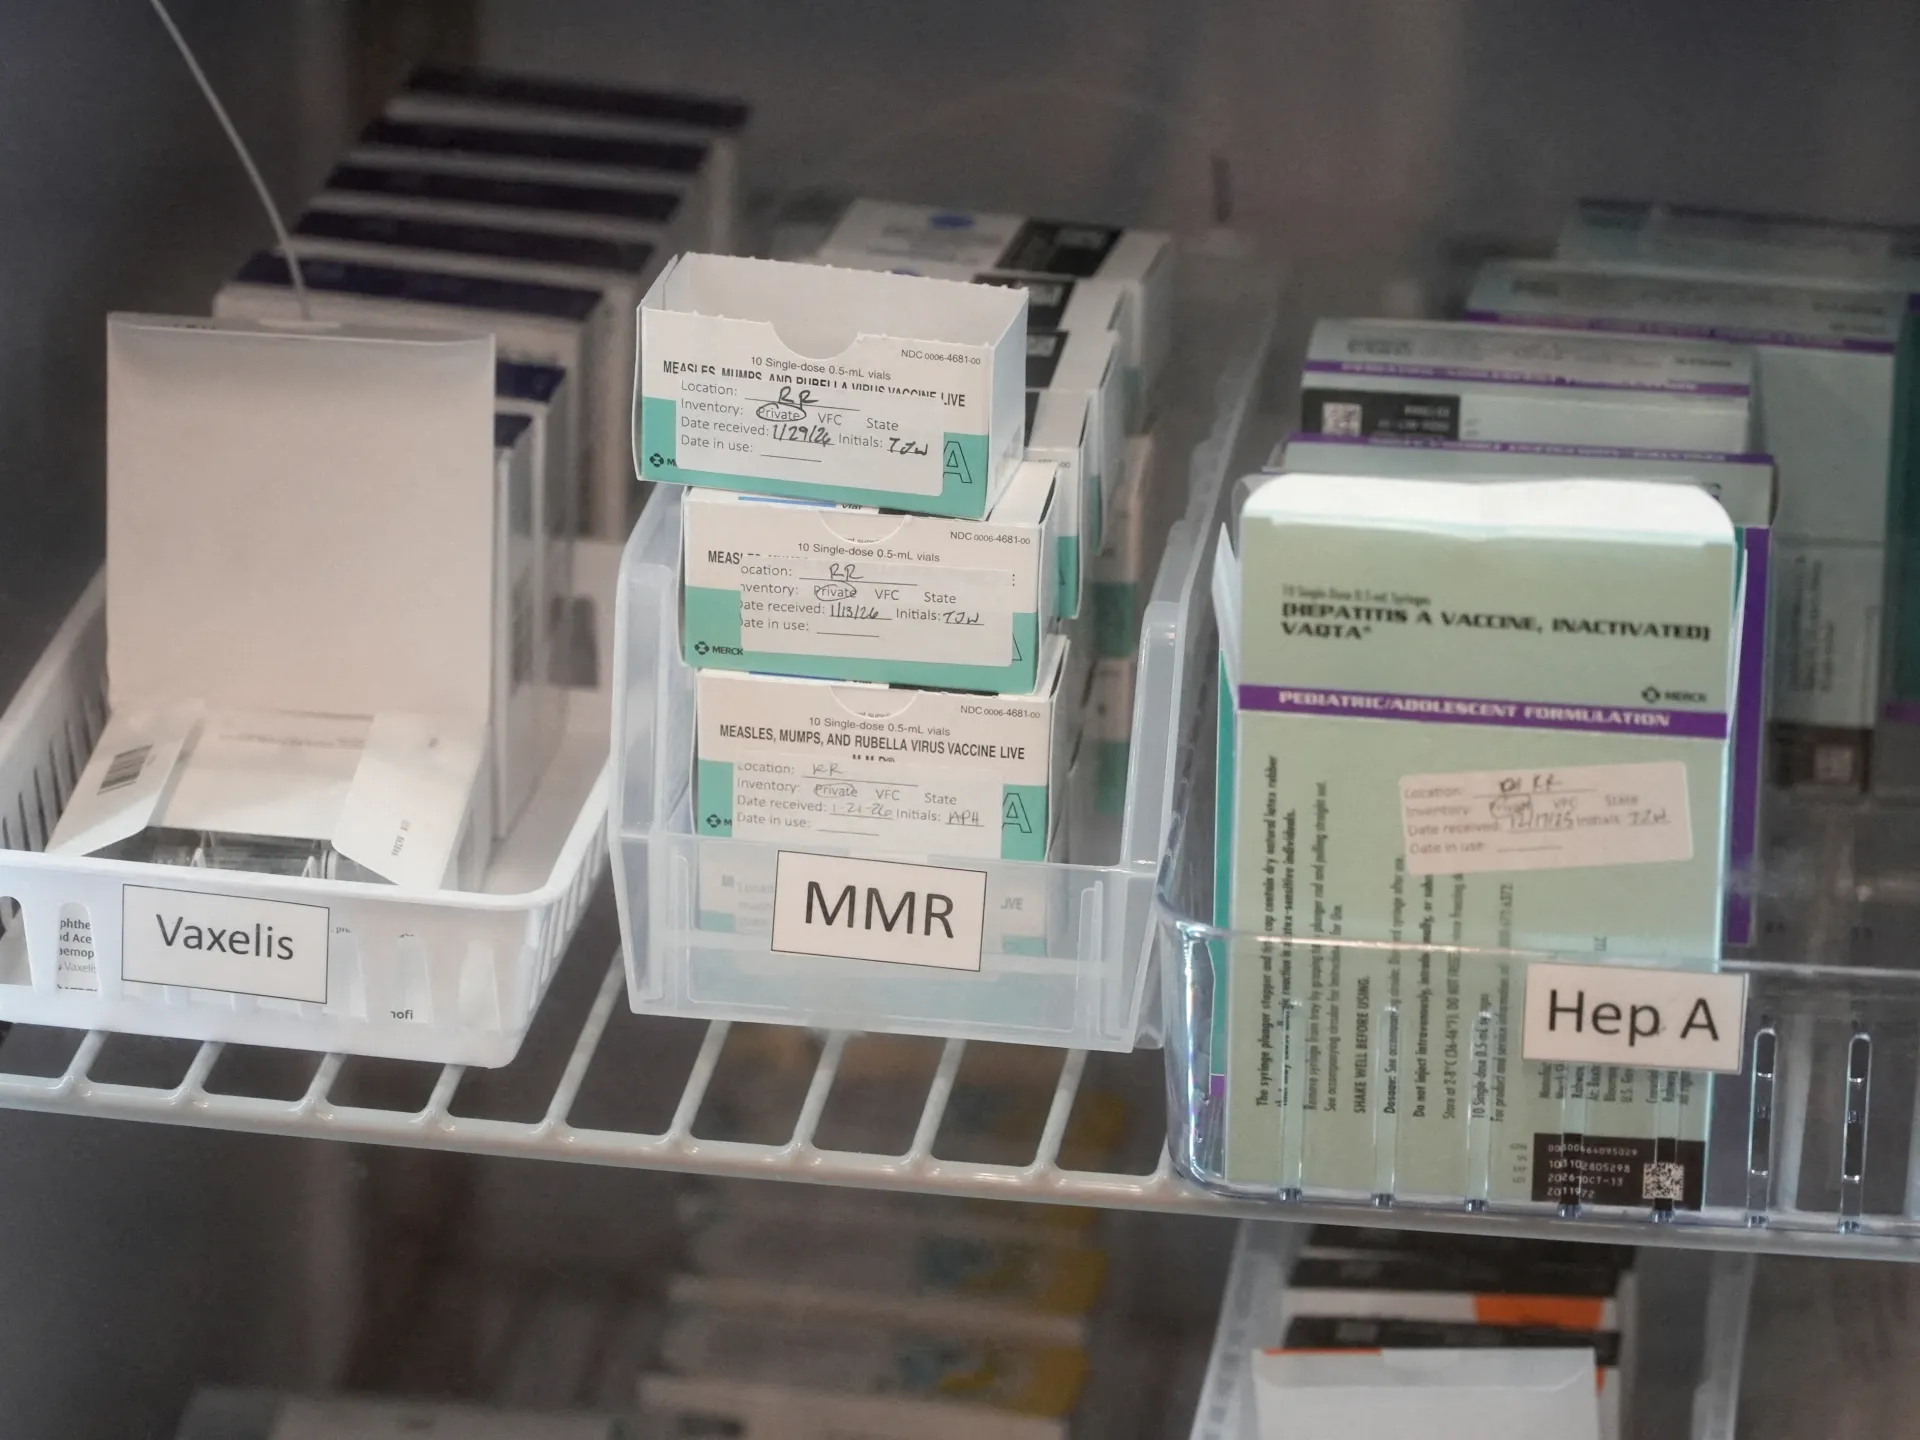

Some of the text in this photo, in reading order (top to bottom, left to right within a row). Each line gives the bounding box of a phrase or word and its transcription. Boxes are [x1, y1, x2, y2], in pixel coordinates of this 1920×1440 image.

[901, 349, 981, 365] NDC 0006-4681-00
[751, 356, 891, 381] 10 Single-dose 0.5-mL vials
[681, 380, 737, 397] Location:
[681, 398, 899, 431] Inventory: Private VFC State
[681, 416, 710, 430] Date
[713, 419, 769, 436] received:
[838, 433, 883, 448] Initials:
[681, 434, 753, 453] Date in use:
[950, 531, 1031, 545] NDC 0006-4681-00
[708, 550, 743, 564] MEAS
[798, 543, 810, 552] 10
[813, 543, 874, 557] Single-dose
[877, 548, 914, 561] 0.5-mL
[917, 552, 940, 562] vials
[741, 565, 792, 577] ocation:
[741, 583, 957, 604] nventory: Private VFC State
[768, 602, 826, 615] received:
[896, 607, 941, 621] Initials:
[768, 618, 779, 629] in
[783, 621, 810, 632] use:
[1417, 610, 1432, 626] A
[1441, 610, 1543, 635] VACCINE,
[712, 645, 744, 656] MERCK
[960, 705, 1041, 719] NDC 0006-4681-00
[1278, 690, 1671, 728] PEDIATRIC/ADOLESCENT FORMULATION
[809, 717, 950, 737] 10 Single-dose 0.5-mL vials
[720, 724, 1025, 760] MEASLES, MUMPS, AND RUBELLA VIRUS VACCINE LIVE
[737, 762, 795, 775] Location:
[737, 777, 957, 805] Inventory: Private VFC State
[737, 794, 766, 807] Date
[770, 799, 827, 812] received:
[896, 807, 941, 822] Initials:
[737, 812, 766, 825] Date
[770, 814, 781, 826] in
[784, 817, 811, 828] use:
[1408, 825, 1439, 837] Date
[1409, 843, 1441, 855] Date
[1444, 844, 1457, 853] in
[1261, 857, 1280, 875] dry
[805, 880, 954, 939] MMR
[155, 912, 294, 961] Vaxelis
[1548, 988, 1661, 1047] Hep
[1680, 997, 1720, 1041] A
[1259, 1012, 1275, 1050] plunger
[1354, 1012, 1370, 1050] BEFORE
[1259, 1051, 1274, 1087] syringe
[1354, 1052, 1368, 1079] WELL
[1413, 1057, 1430, 1084] inject
[1256, 1089, 1269, 1107] The
[1353, 1081, 1369, 1114] SHAKE
[1413, 1086, 1427, 1102] not
[1411, 1105, 1426, 1118] Do
[1471, 1108, 1485, 1119] 10
[1490, 1109, 1504, 1122] For
